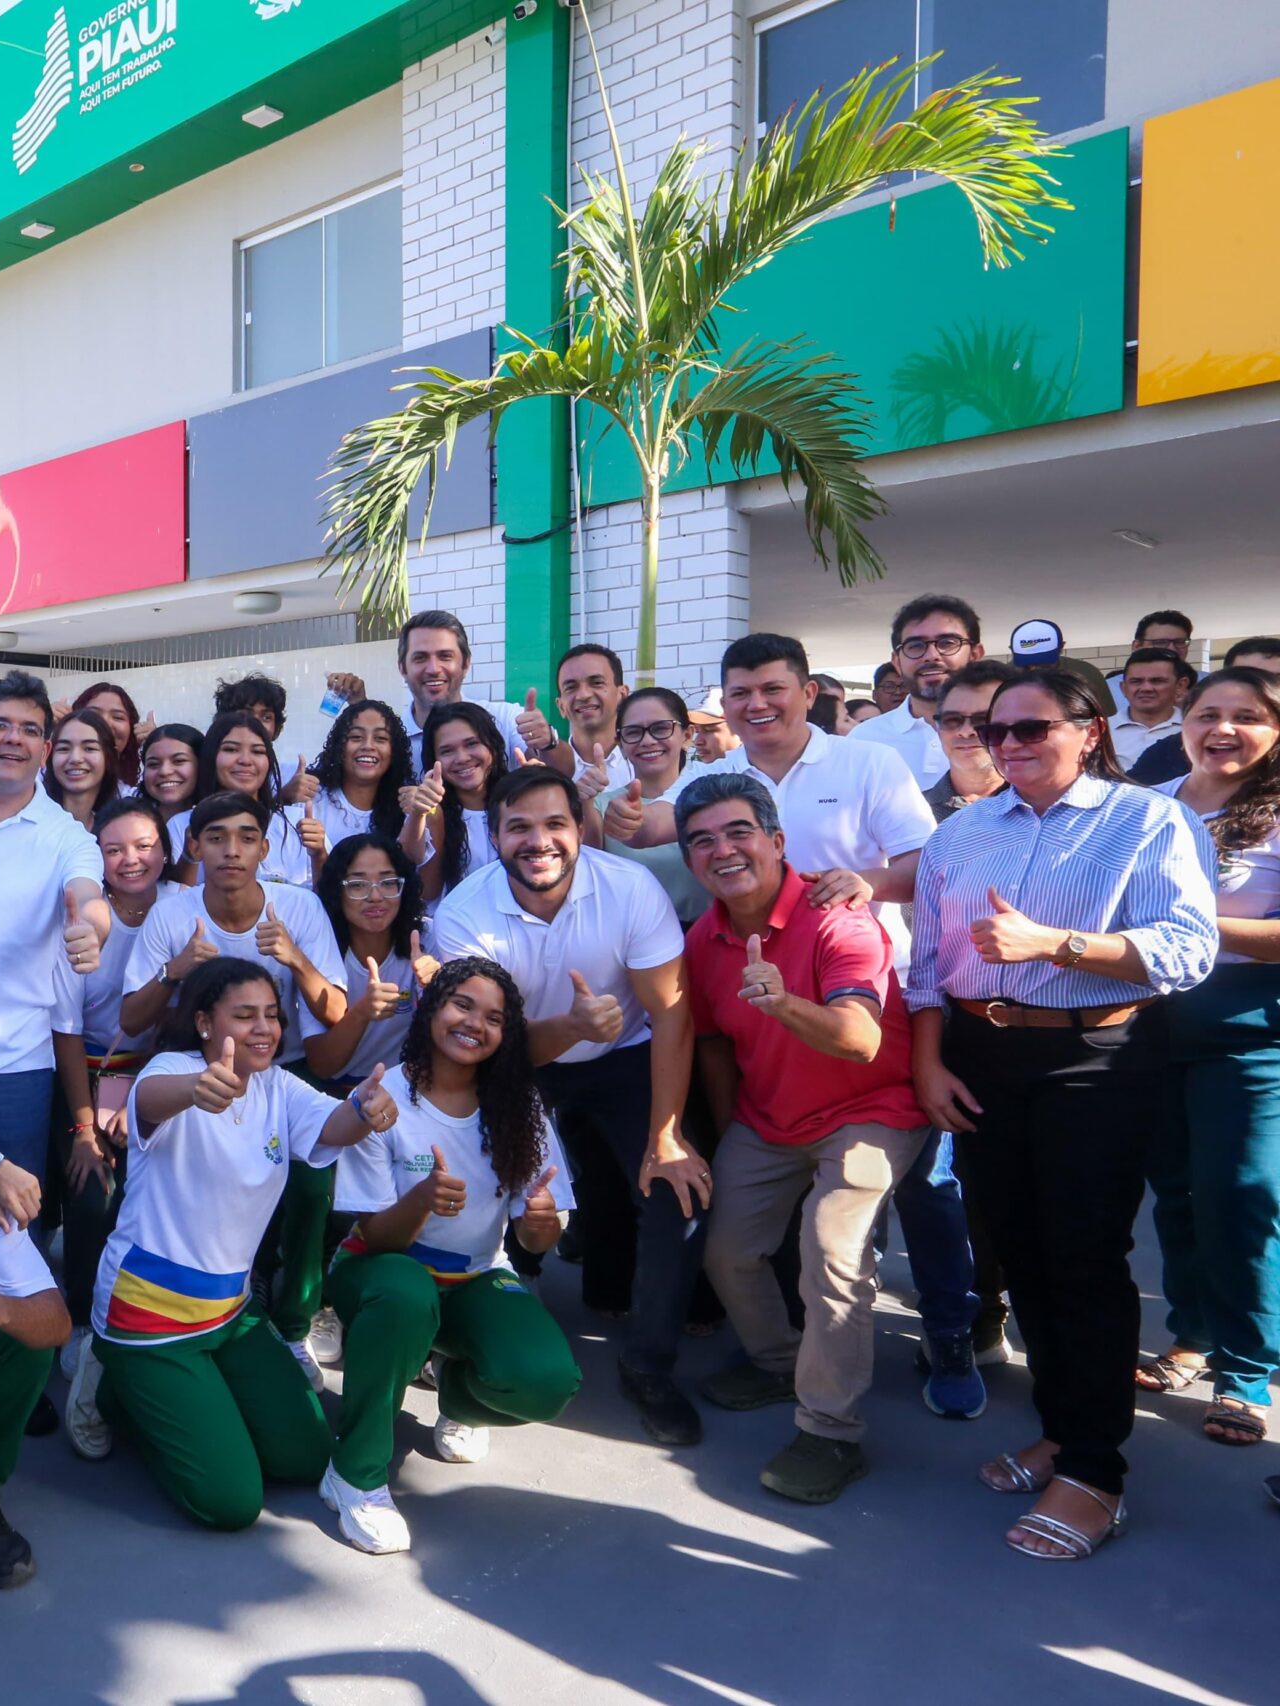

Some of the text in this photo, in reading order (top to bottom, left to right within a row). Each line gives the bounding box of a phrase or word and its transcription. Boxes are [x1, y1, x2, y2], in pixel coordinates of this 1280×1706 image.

[79, 37, 176, 101] AQUI TEM TRABALHO.
[79, 60, 162, 115] AQUI TEM FUTURO.
